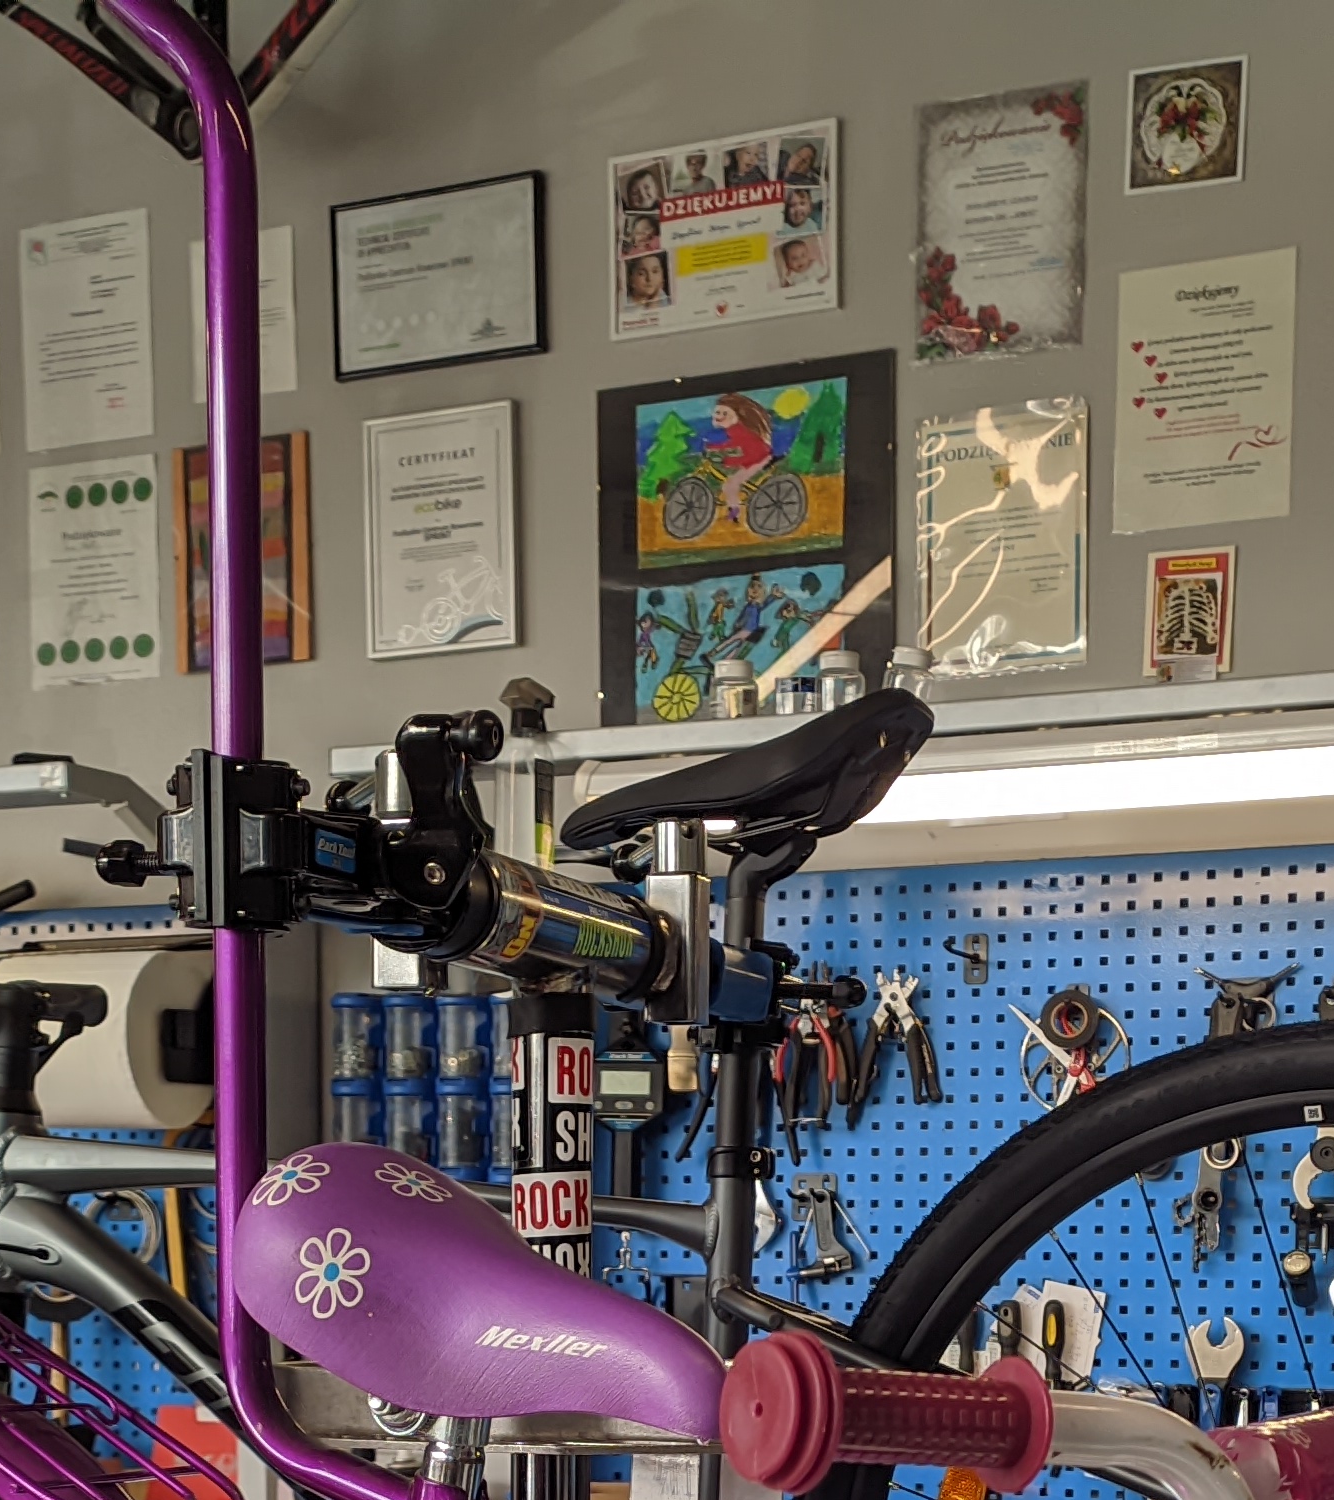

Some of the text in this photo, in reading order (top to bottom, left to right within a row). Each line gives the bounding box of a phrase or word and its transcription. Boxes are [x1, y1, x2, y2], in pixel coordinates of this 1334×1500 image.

[662, 183, 783, 216] DZIĘKUJEMY!
[398, 447, 476, 468] CERTYFIKAT
[514, 1178, 589, 1231] ROCK
[475, 1325, 609, 1358] Mexller
